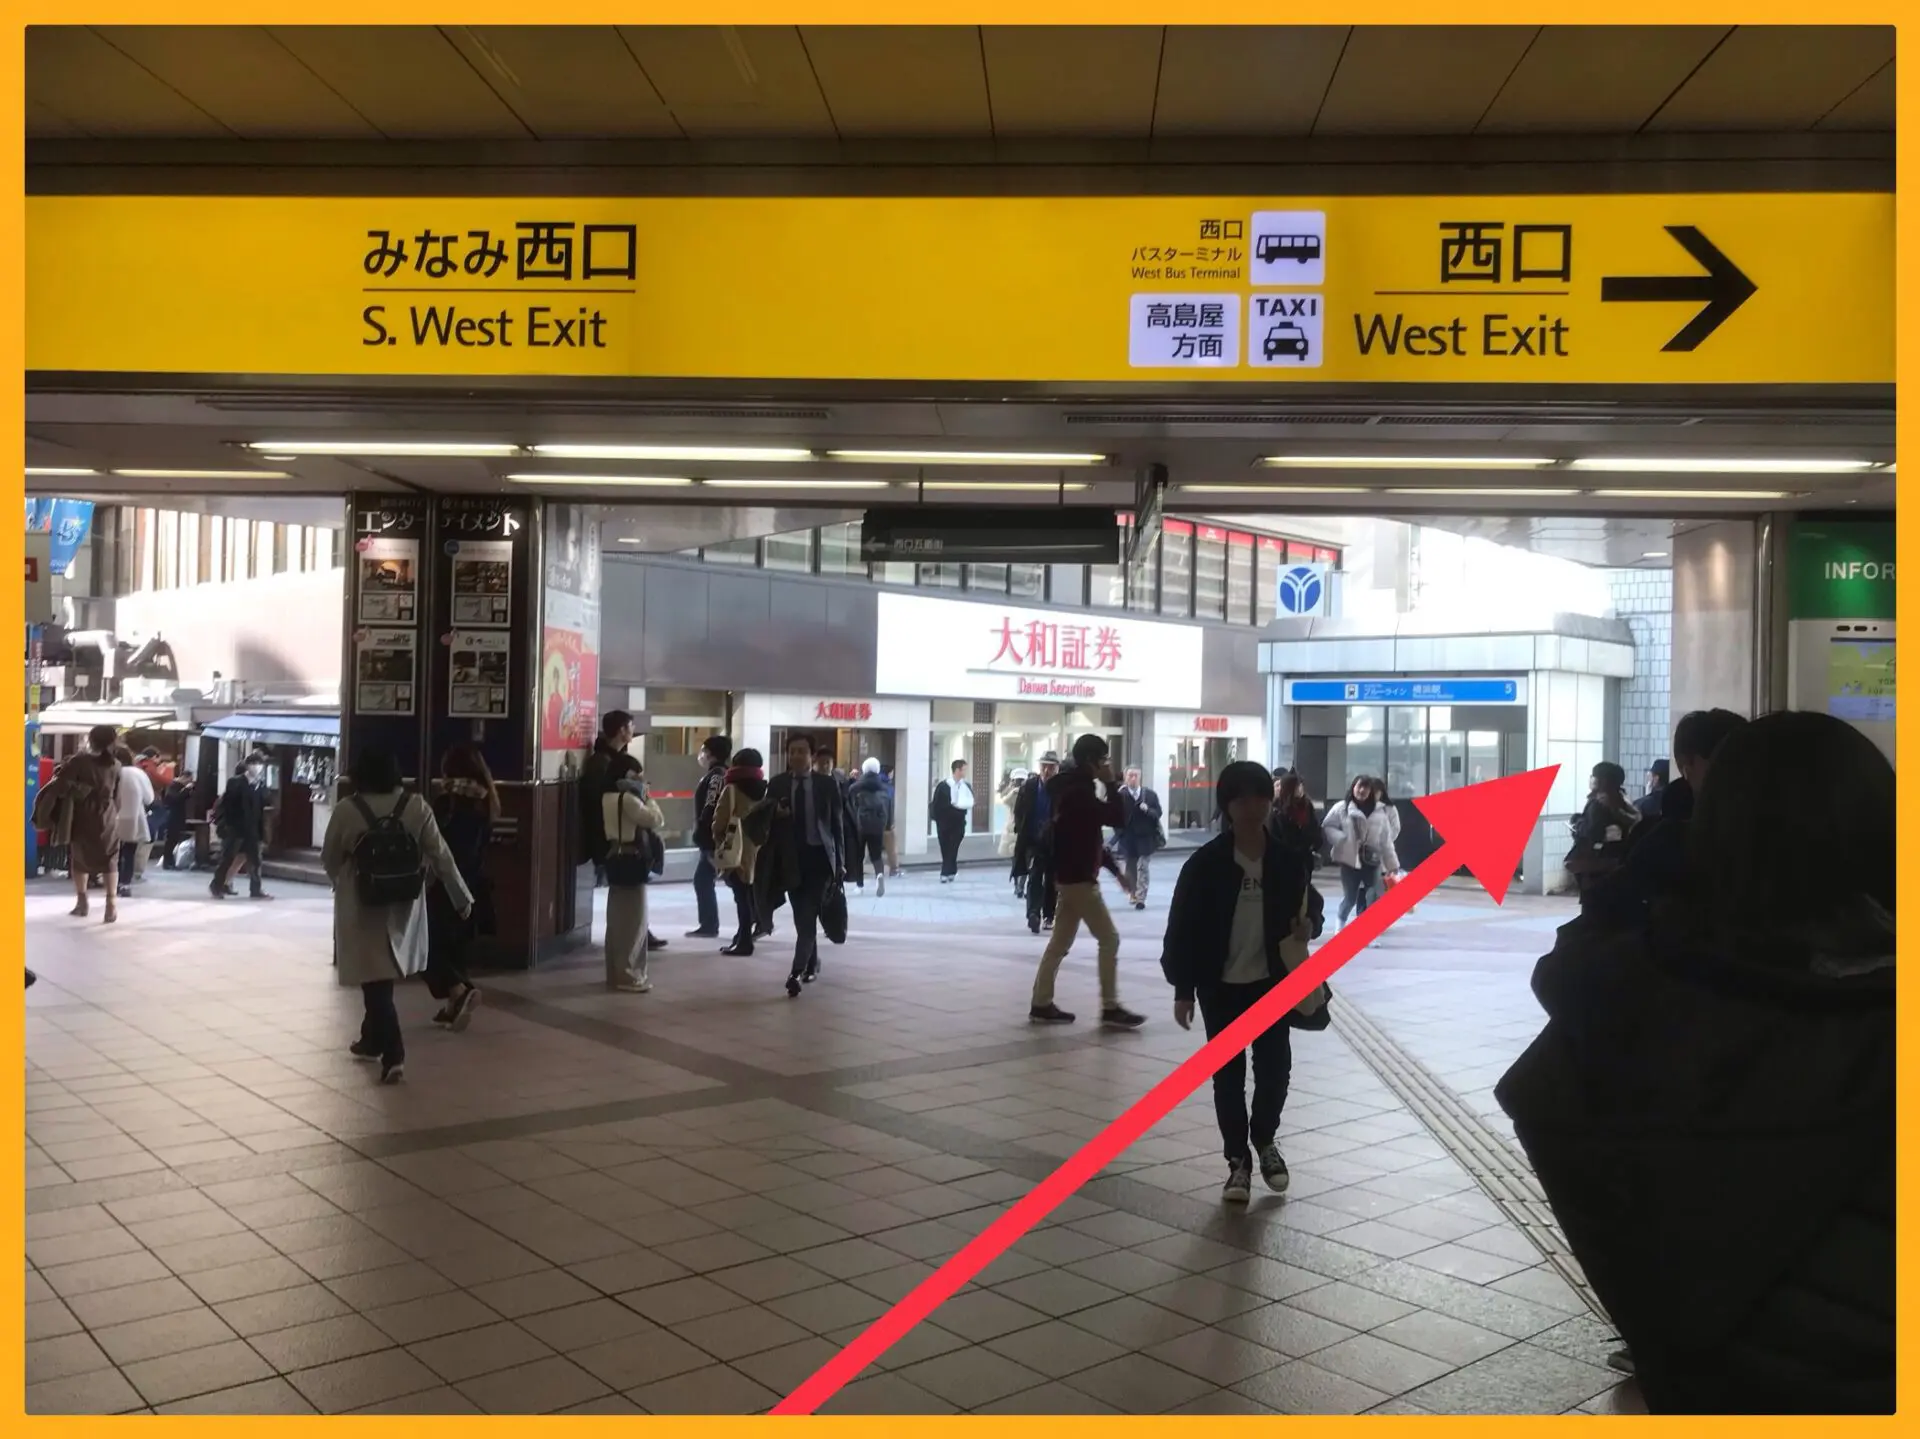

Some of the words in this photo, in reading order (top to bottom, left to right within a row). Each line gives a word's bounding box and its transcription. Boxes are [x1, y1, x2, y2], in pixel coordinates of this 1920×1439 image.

[1199, 219, 1244, 241] 西口
[363, 222, 637, 281] みなみ西口
[1131, 246, 1243, 262] バスターミナル
[1439, 221, 1573, 284] 西口
[1131, 266, 1161, 279] West
[1165, 266, 1186, 279] Bus
[1190, 266, 1241, 279] Terminal
[1146, 303, 1225, 329] 高島屋
[1256, 298, 1318, 317] TAXI
[362, 305, 397, 346] S.
[409, 305, 514, 347] West
[527, 306, 608, 348] Exit
[1353, 313, 1468, 357] West
[1482, 313, 1570, 357] Exit
[1172, 333, 1224, 359] 方面
[1824, 561, 1896, 580] INFOR
[987, 616, 1123, 672] 大和証券
[1017, 676, 1048, 695] Daiwa
[1050, 678, 1096, 698] Securities
[1504, 683, 1513, 695] 5
